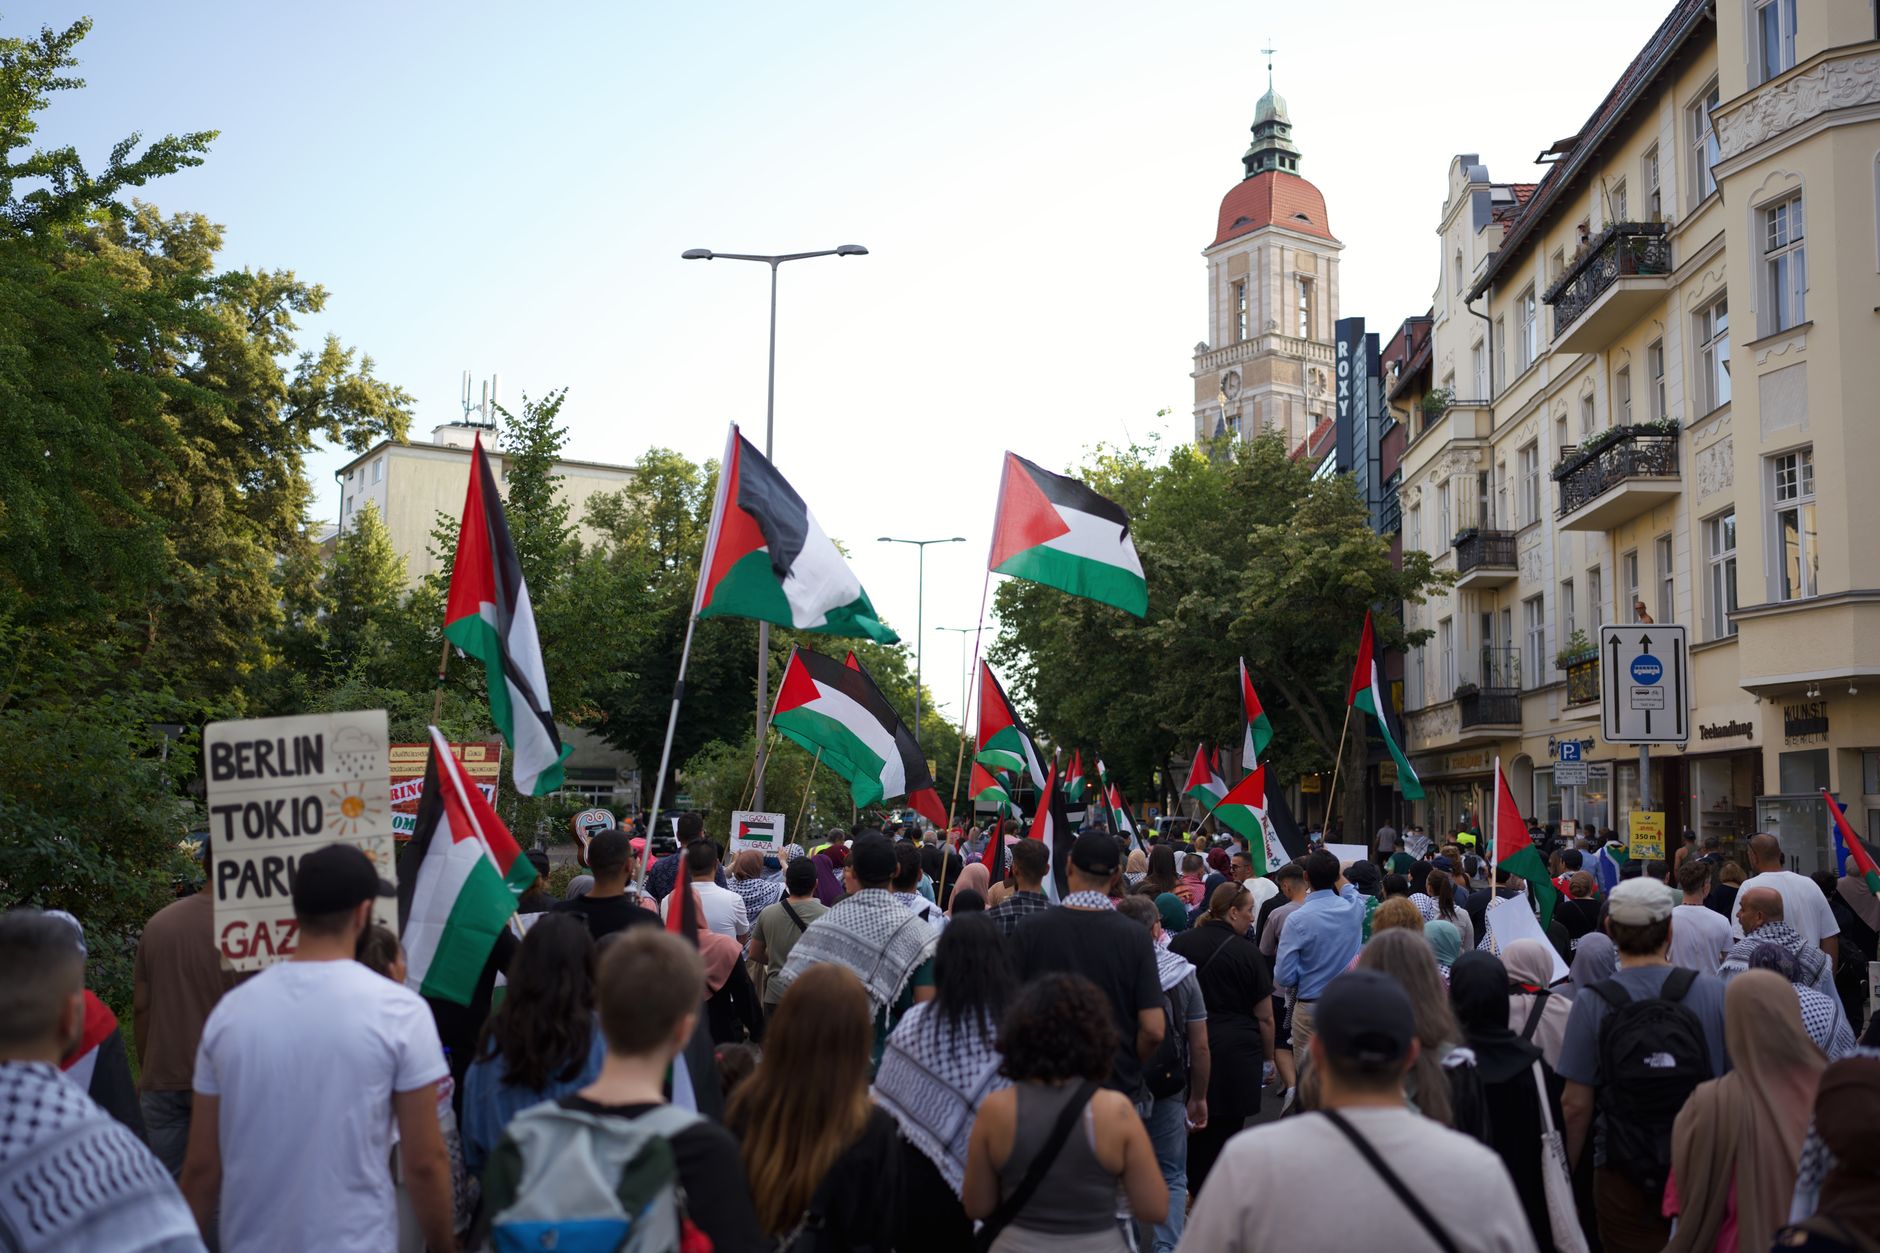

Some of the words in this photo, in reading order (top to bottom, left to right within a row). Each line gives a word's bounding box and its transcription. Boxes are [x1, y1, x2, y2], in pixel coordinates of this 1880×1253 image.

[1338, 341, 1349, 416] ROXY
[1784, 701, 1828, 721] KUNST
[1699, 720, 1753, 740] Teehandlung
[1785, 732, 1828, 746] BERLIN
[210, 733, 324, 782] BERLIN
[1563, 744, 1575, 760] P
[391, 782, 424, 801] RIN
[211, 795, 323, 842] TOKIO
[392, 816, 416, 831] OM
[749, 815, 768, 823] GAZA
[752, 841, 773, 849] GAZA
[218, 855, 299, 900] PARI
[221, 919, 300, 960] GAZ
